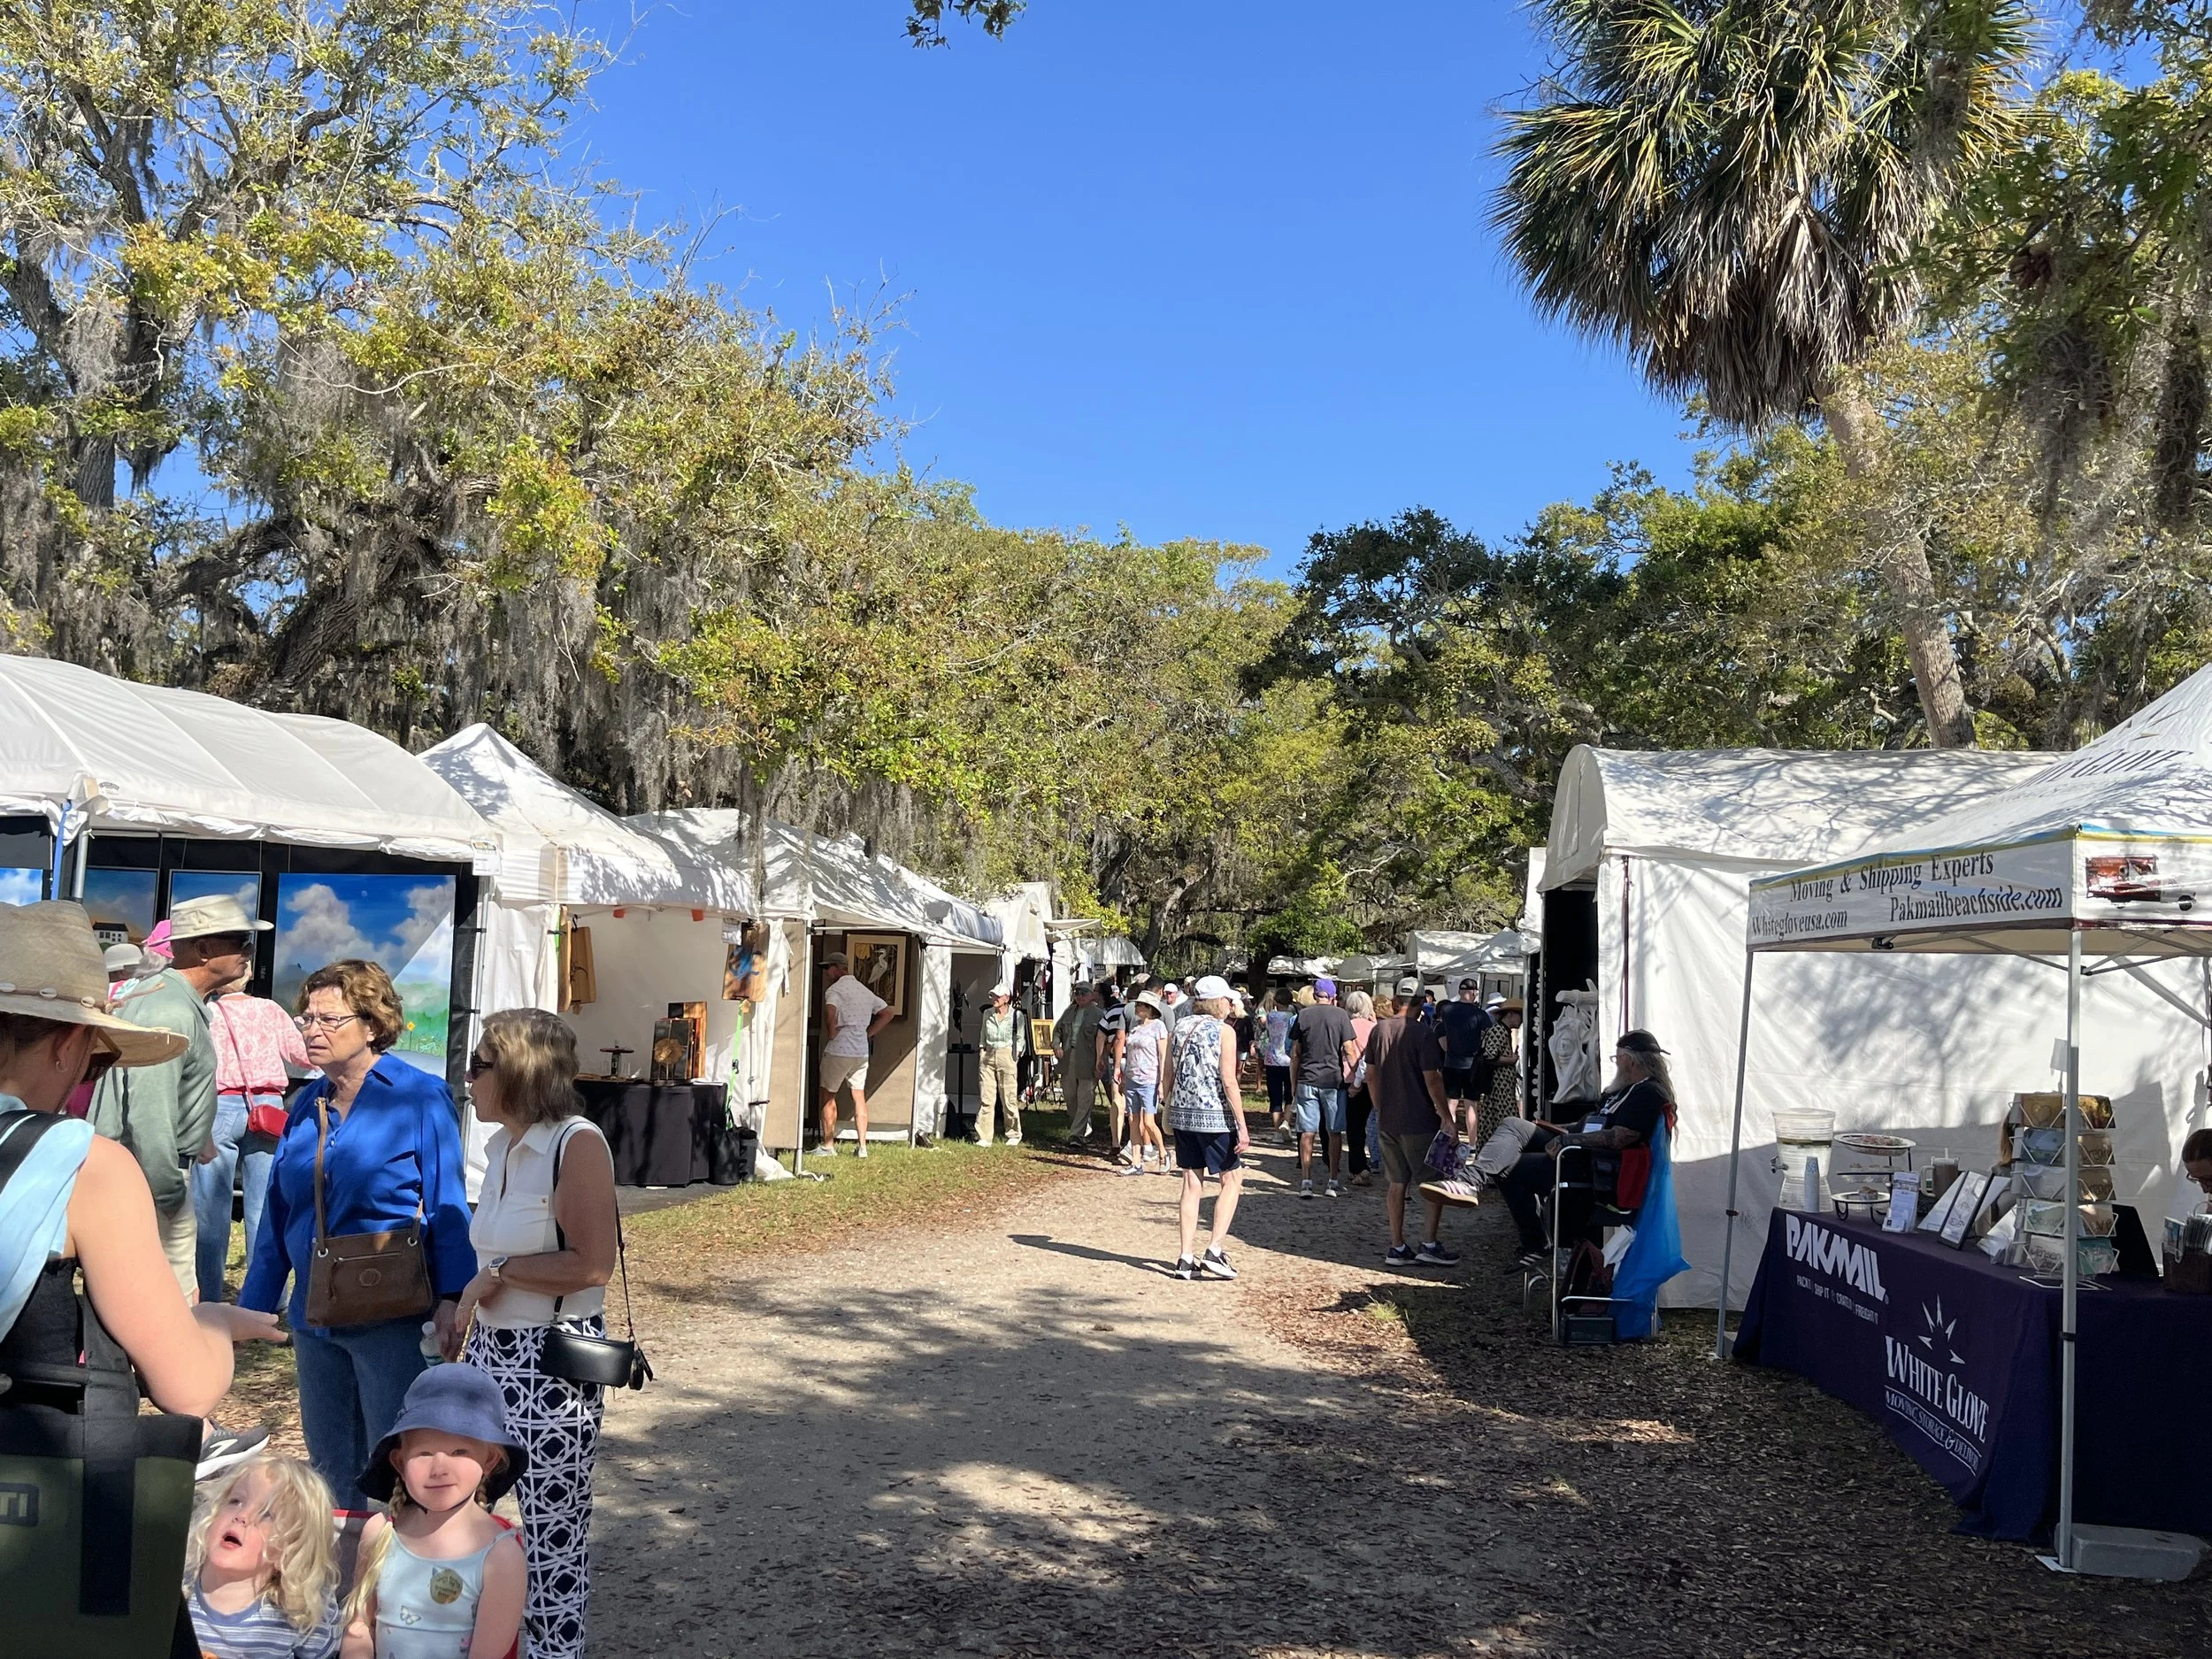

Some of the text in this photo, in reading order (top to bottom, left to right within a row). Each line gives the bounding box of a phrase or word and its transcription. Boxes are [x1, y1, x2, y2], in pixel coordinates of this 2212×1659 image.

[1790, 849, 1994, 902] Moving & Shipping Experts
[1752, 885, 2063, 941] Whitegloveusa.com Pakmailbeachside.com
[1786, 1213, 1886, 1302] PAKMAIL
[1885, 1335, 1989, 1443] WHITE GLOVE
